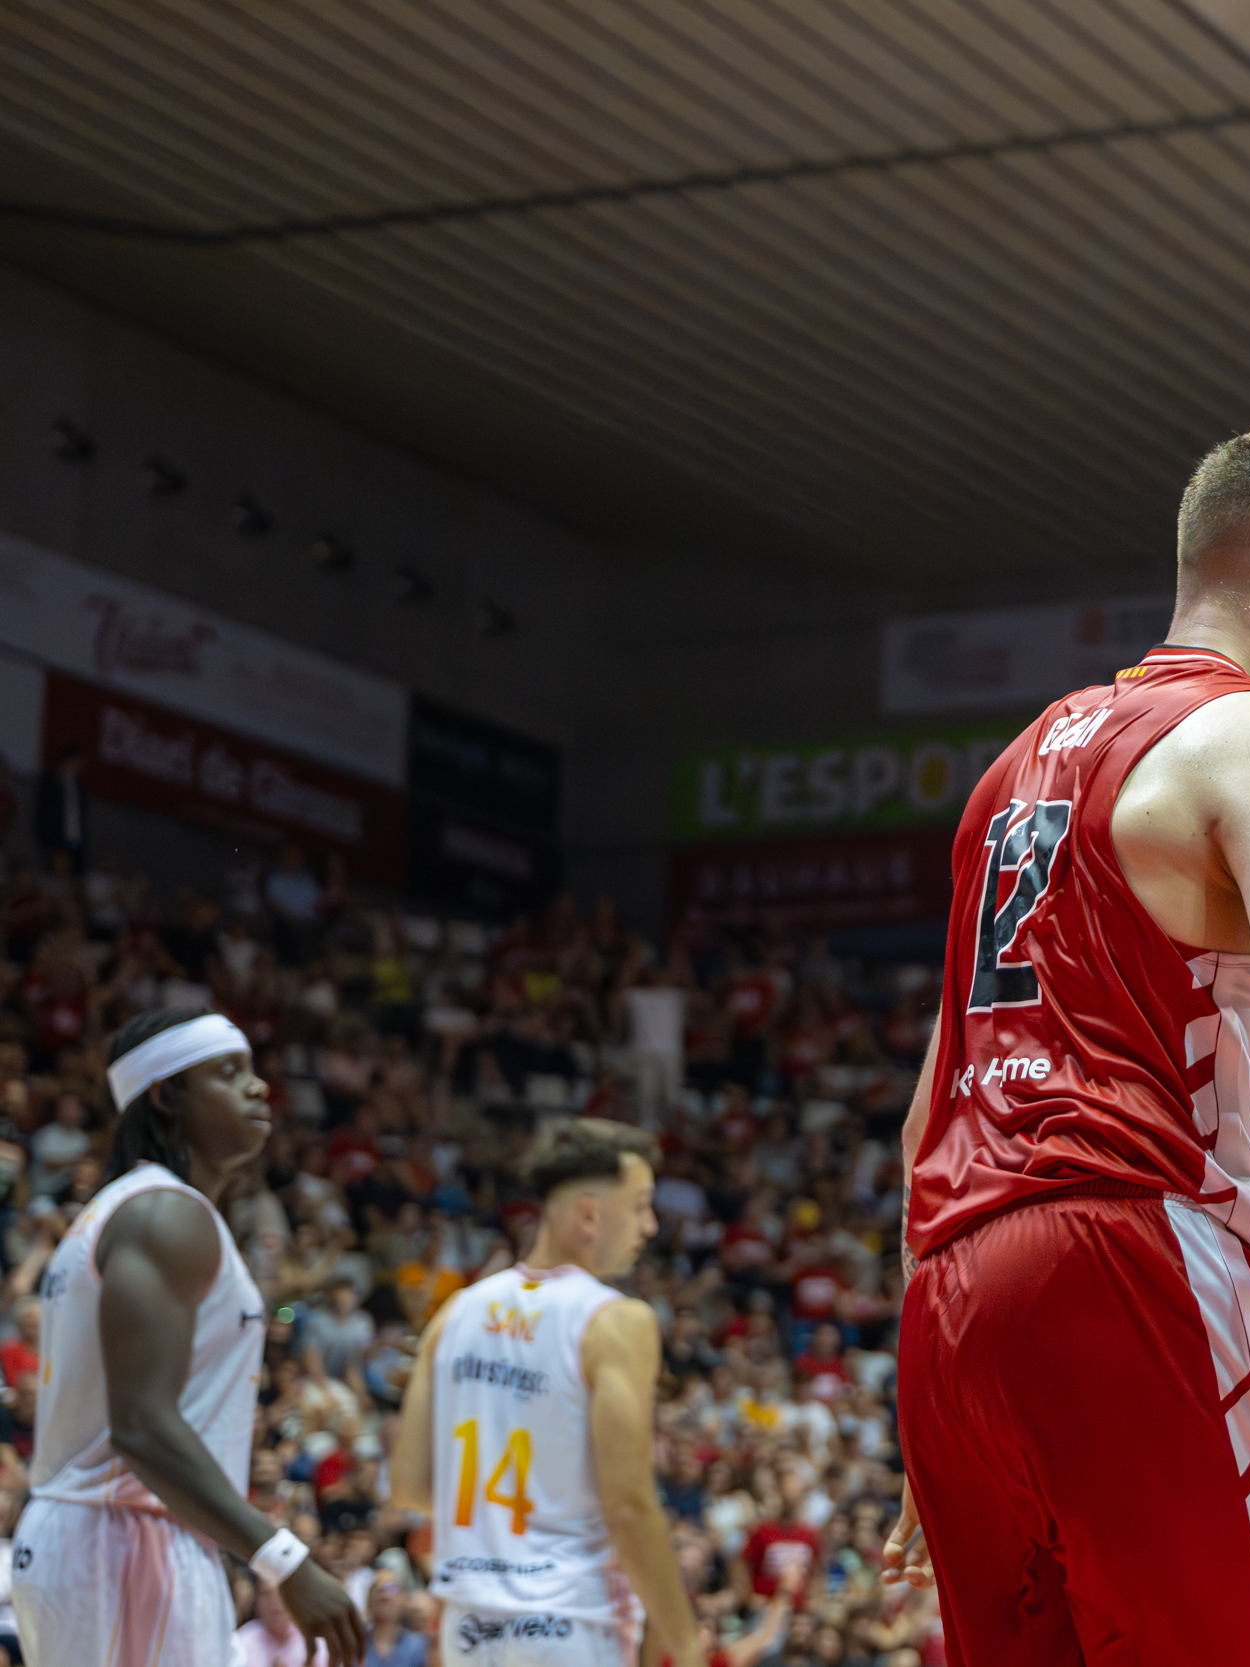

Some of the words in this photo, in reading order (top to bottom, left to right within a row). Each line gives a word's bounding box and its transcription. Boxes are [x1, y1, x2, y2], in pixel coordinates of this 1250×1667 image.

[966, 799, 1074, 1015] 12
[981, 1057, 1052, 1088] Hme
[452, 1417, 535, 1536] 14
